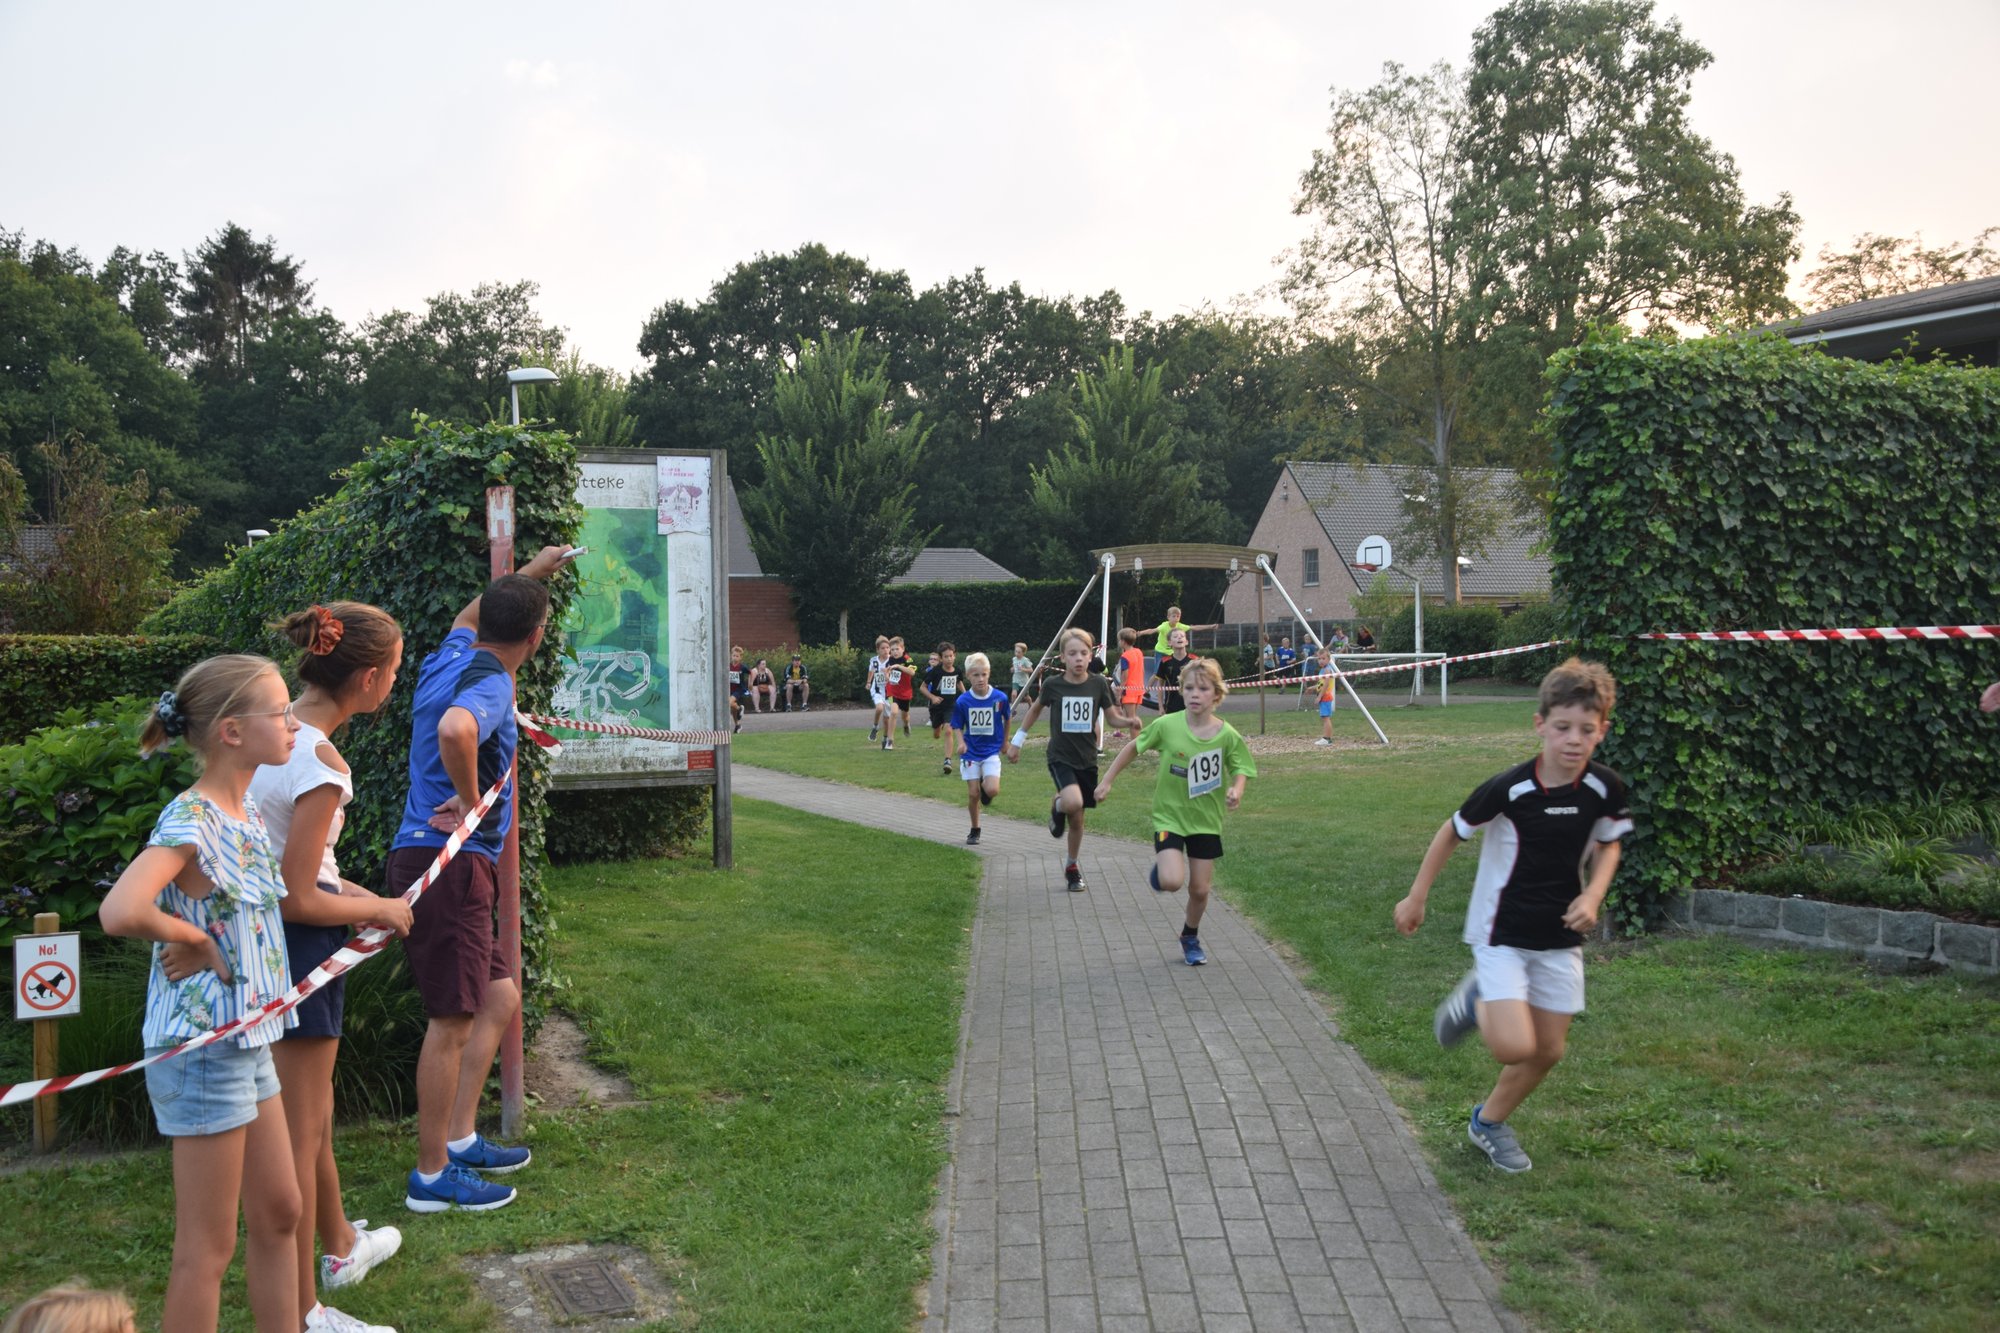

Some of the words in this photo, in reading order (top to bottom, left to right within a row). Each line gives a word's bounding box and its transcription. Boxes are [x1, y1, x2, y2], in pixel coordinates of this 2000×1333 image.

[943, 677, 956, 689] 199
[971, 710, 992, 726] 202
[1064, 701, 1090, 721] 198
[1191, 753, 1220, 783] 193
[39, 944, 57, 956] No!
